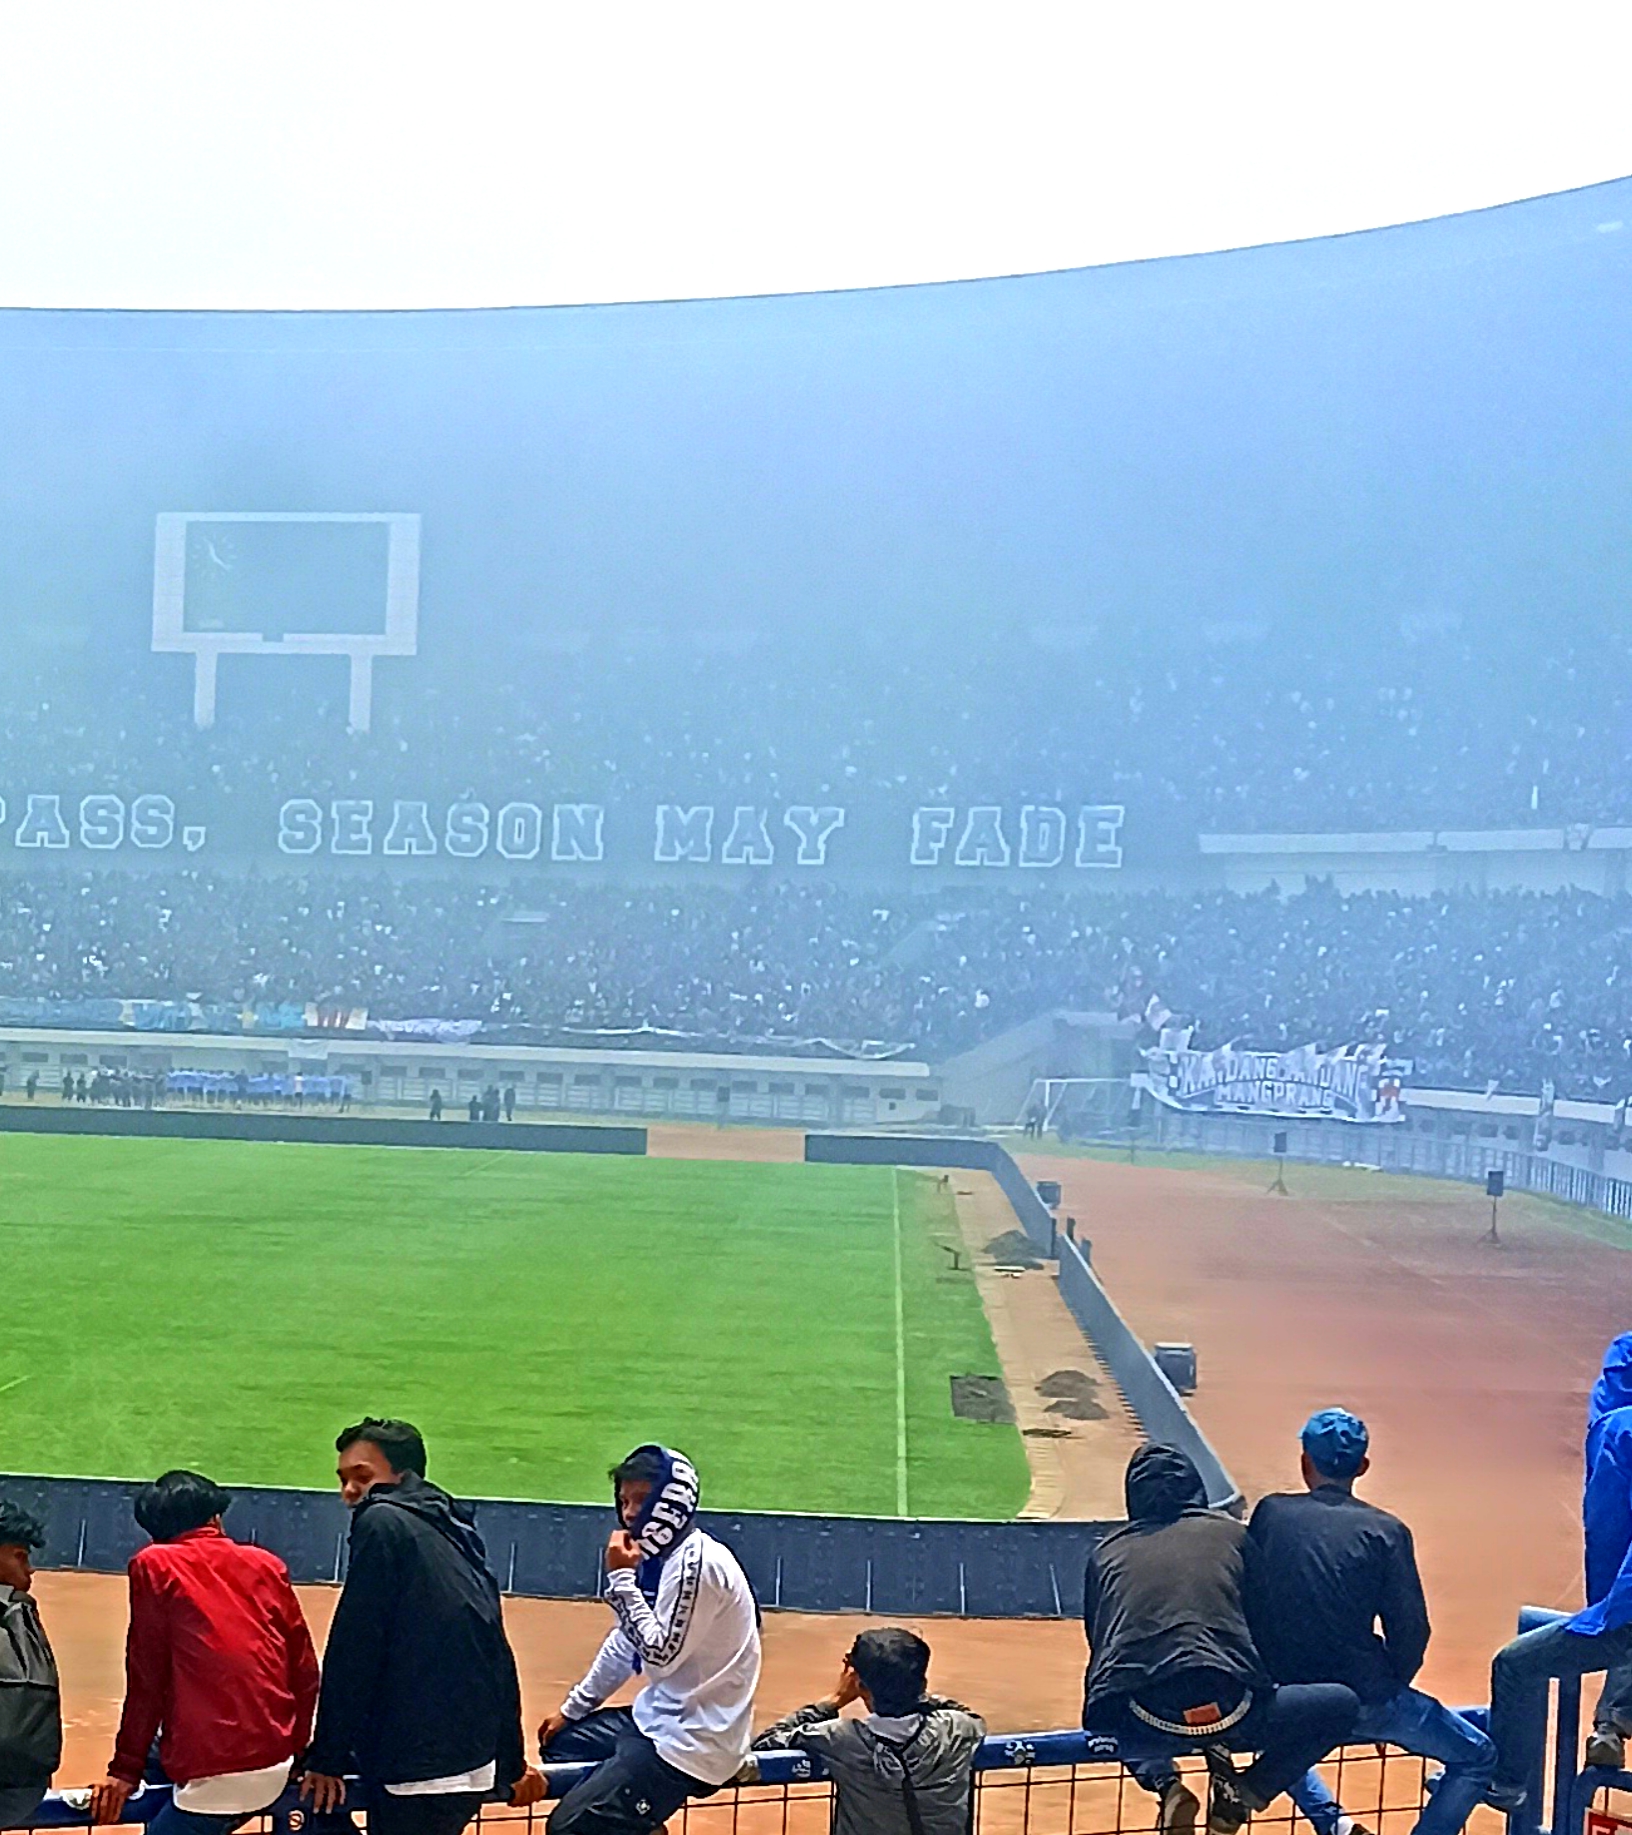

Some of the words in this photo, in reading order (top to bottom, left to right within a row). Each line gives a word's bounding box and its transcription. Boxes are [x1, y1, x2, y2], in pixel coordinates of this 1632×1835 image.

[278, 799, 604, 860] SEASON
[654, 805, 845, 865] MAY
[910, 805, 1125, 868] FADE
